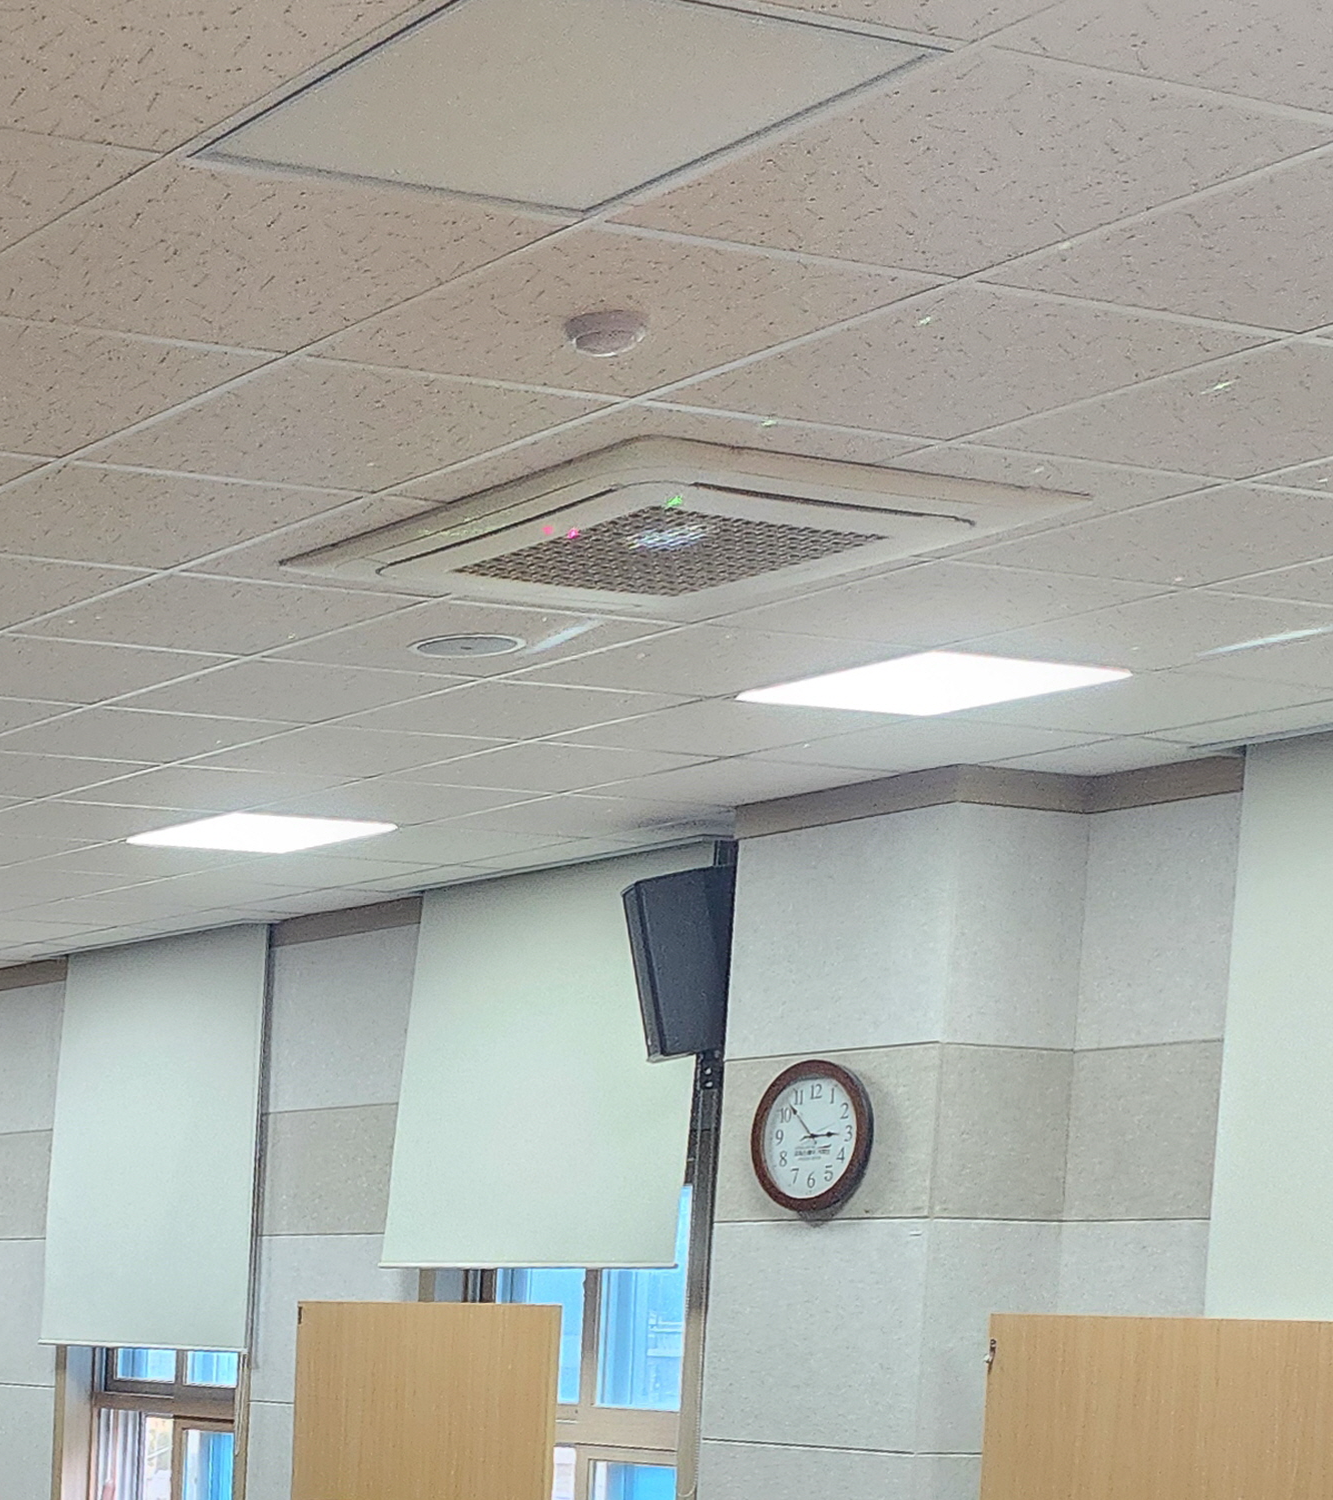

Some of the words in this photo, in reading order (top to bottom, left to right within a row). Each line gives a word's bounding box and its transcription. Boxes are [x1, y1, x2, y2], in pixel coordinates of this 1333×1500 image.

[792, 1088, 804, 1106] 11
[809, 1084, 823, 1100] 12
[829, 1087, 835, 1104] 1
[779, 1108, 792, 1123] 10
[840, 1102, 849, 1119] 2
[775, 1129, 785, 1145] 9
[844, 1125, 853, 1143] 3
[779, 1151, 788, 1167] 8
[836, 1146, 845, 1163] 4
[790, 1168, 800, 1184] 7
[806, 1171, 816, 1189] 6
[823, 1165, 834, 1183] 5
